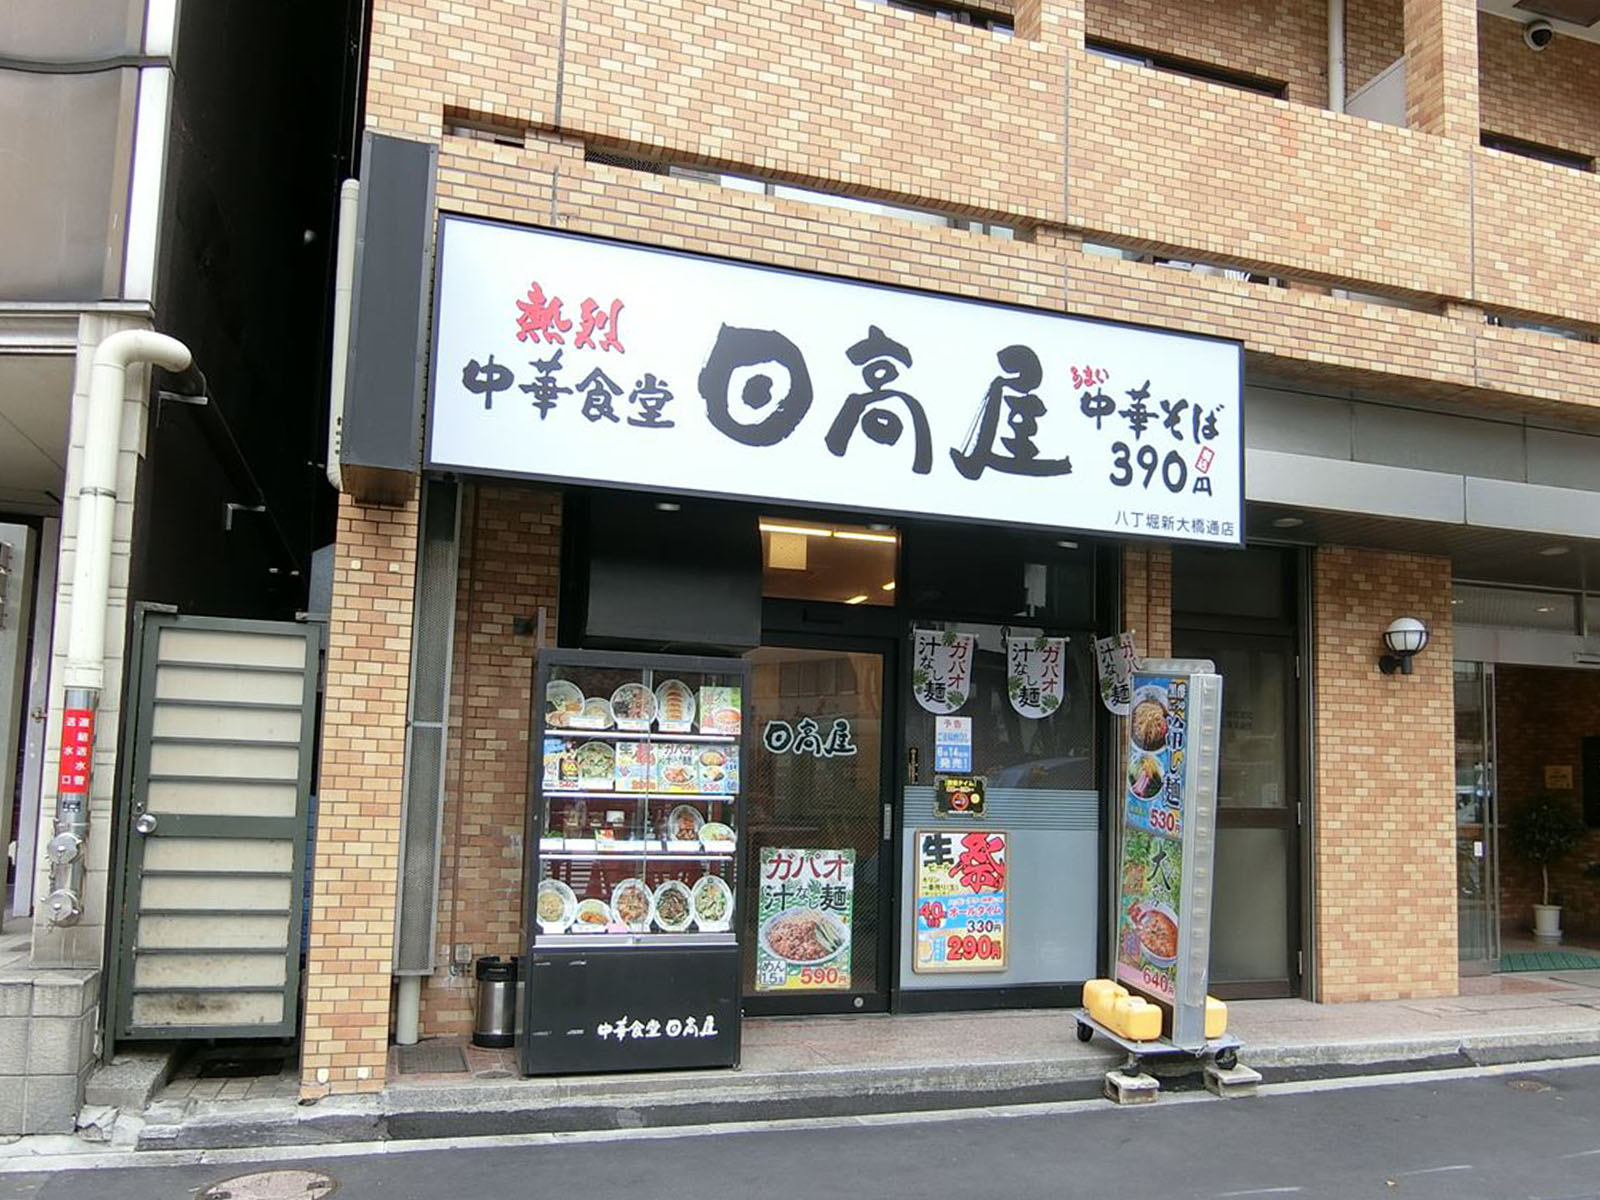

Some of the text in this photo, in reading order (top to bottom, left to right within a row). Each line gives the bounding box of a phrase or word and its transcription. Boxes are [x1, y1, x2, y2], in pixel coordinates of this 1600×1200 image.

[515, 281, 625, 354] 熱烈
[462, 349, 675, 429] 中華食堂
[698, 322, 1073, 481] 日高屋
[1070, 365, 1110, 390] うまい
[1080, 379, 1225, 445] 中華そば
[1115, 510, 1235, 537] 八丁堀新大橋通店
[919, 636, 947, 703] 汁なし麺
[950, 641, 970, 689] ガパオ
[1013, 642, 1042, 708] 汁なし麺
[1042, 645, 1060, 693] ガパオ
[763, 717, 857, 757] 日高屋
[766, 851, 849, 882] ガパオ
[764, 883, 848, 912] 汁なし麺
[597, 1015, 661, 1041] 中華食堂
